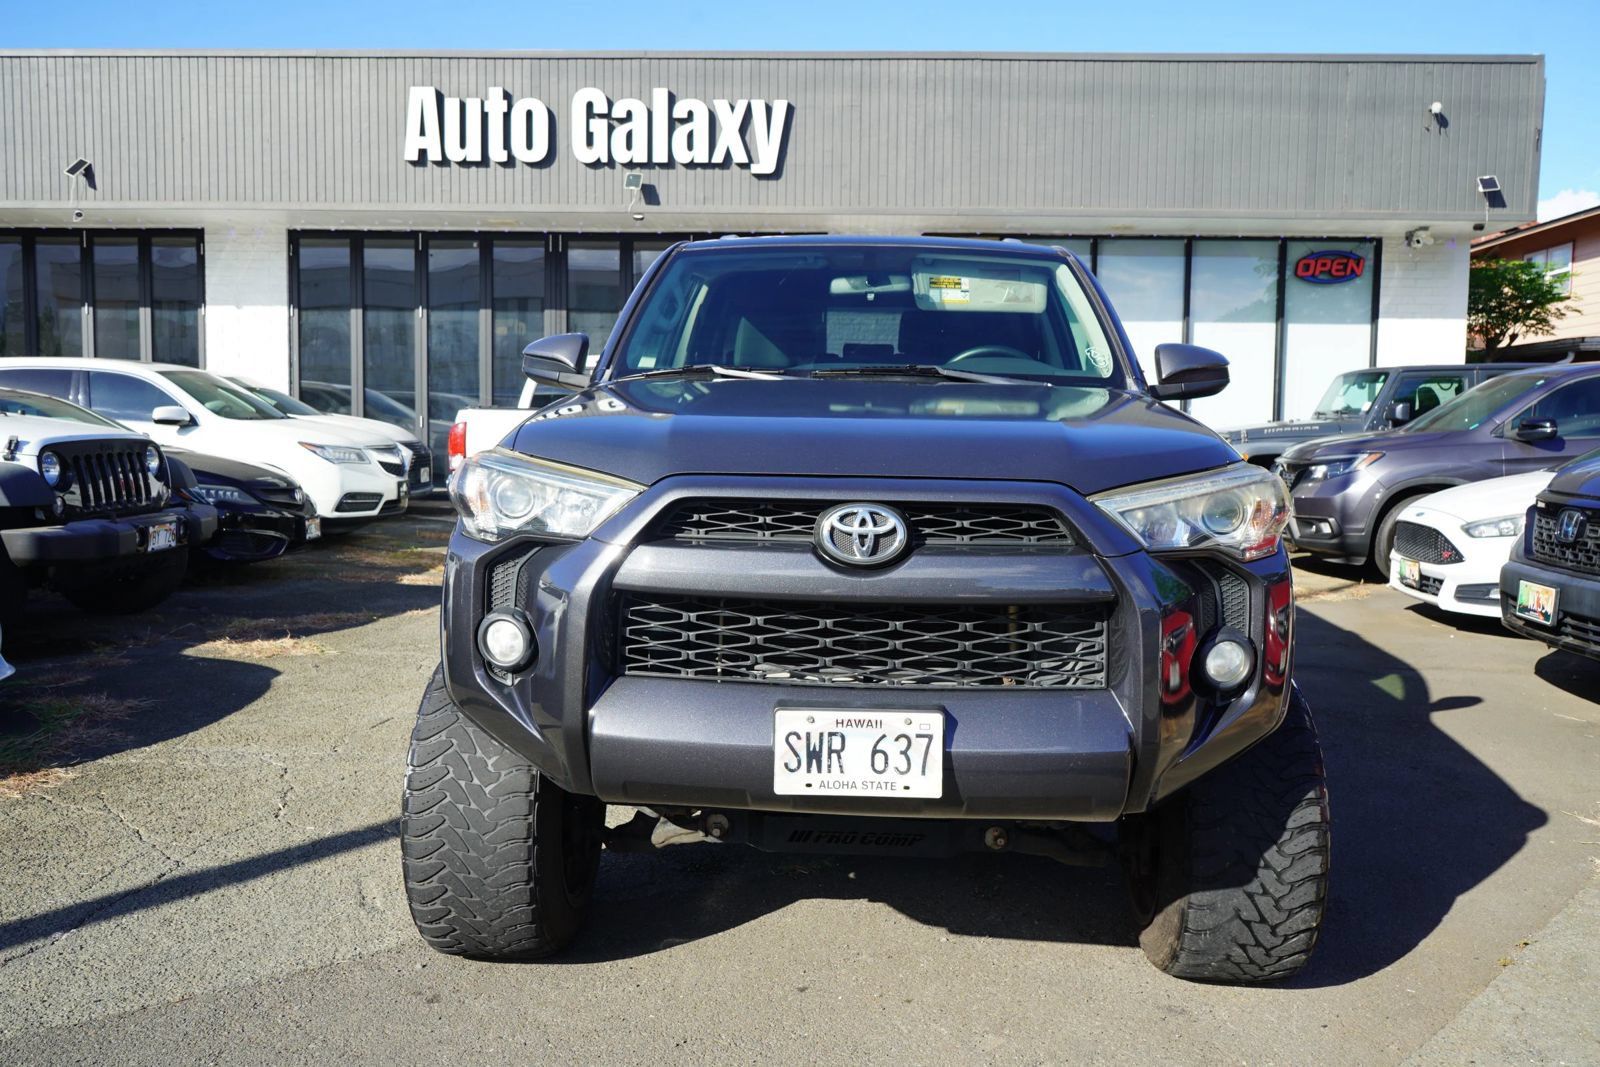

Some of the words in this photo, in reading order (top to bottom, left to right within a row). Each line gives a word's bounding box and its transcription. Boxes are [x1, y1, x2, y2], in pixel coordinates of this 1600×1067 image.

[403, 86, 550, 163] Auto
[571, 86, 789, 174] Galaxy
[1296, 256, 1366, 277] OPEN
[835, 718, 883, 729] HAWAII
[784, 731, 846, 774] SWR
[870, 733, 934, 777] 637
[818, 780, 858, 790] ALOHA
[861, 781, 897, 791] STATE
[813, 830, 858, 845] PRO
